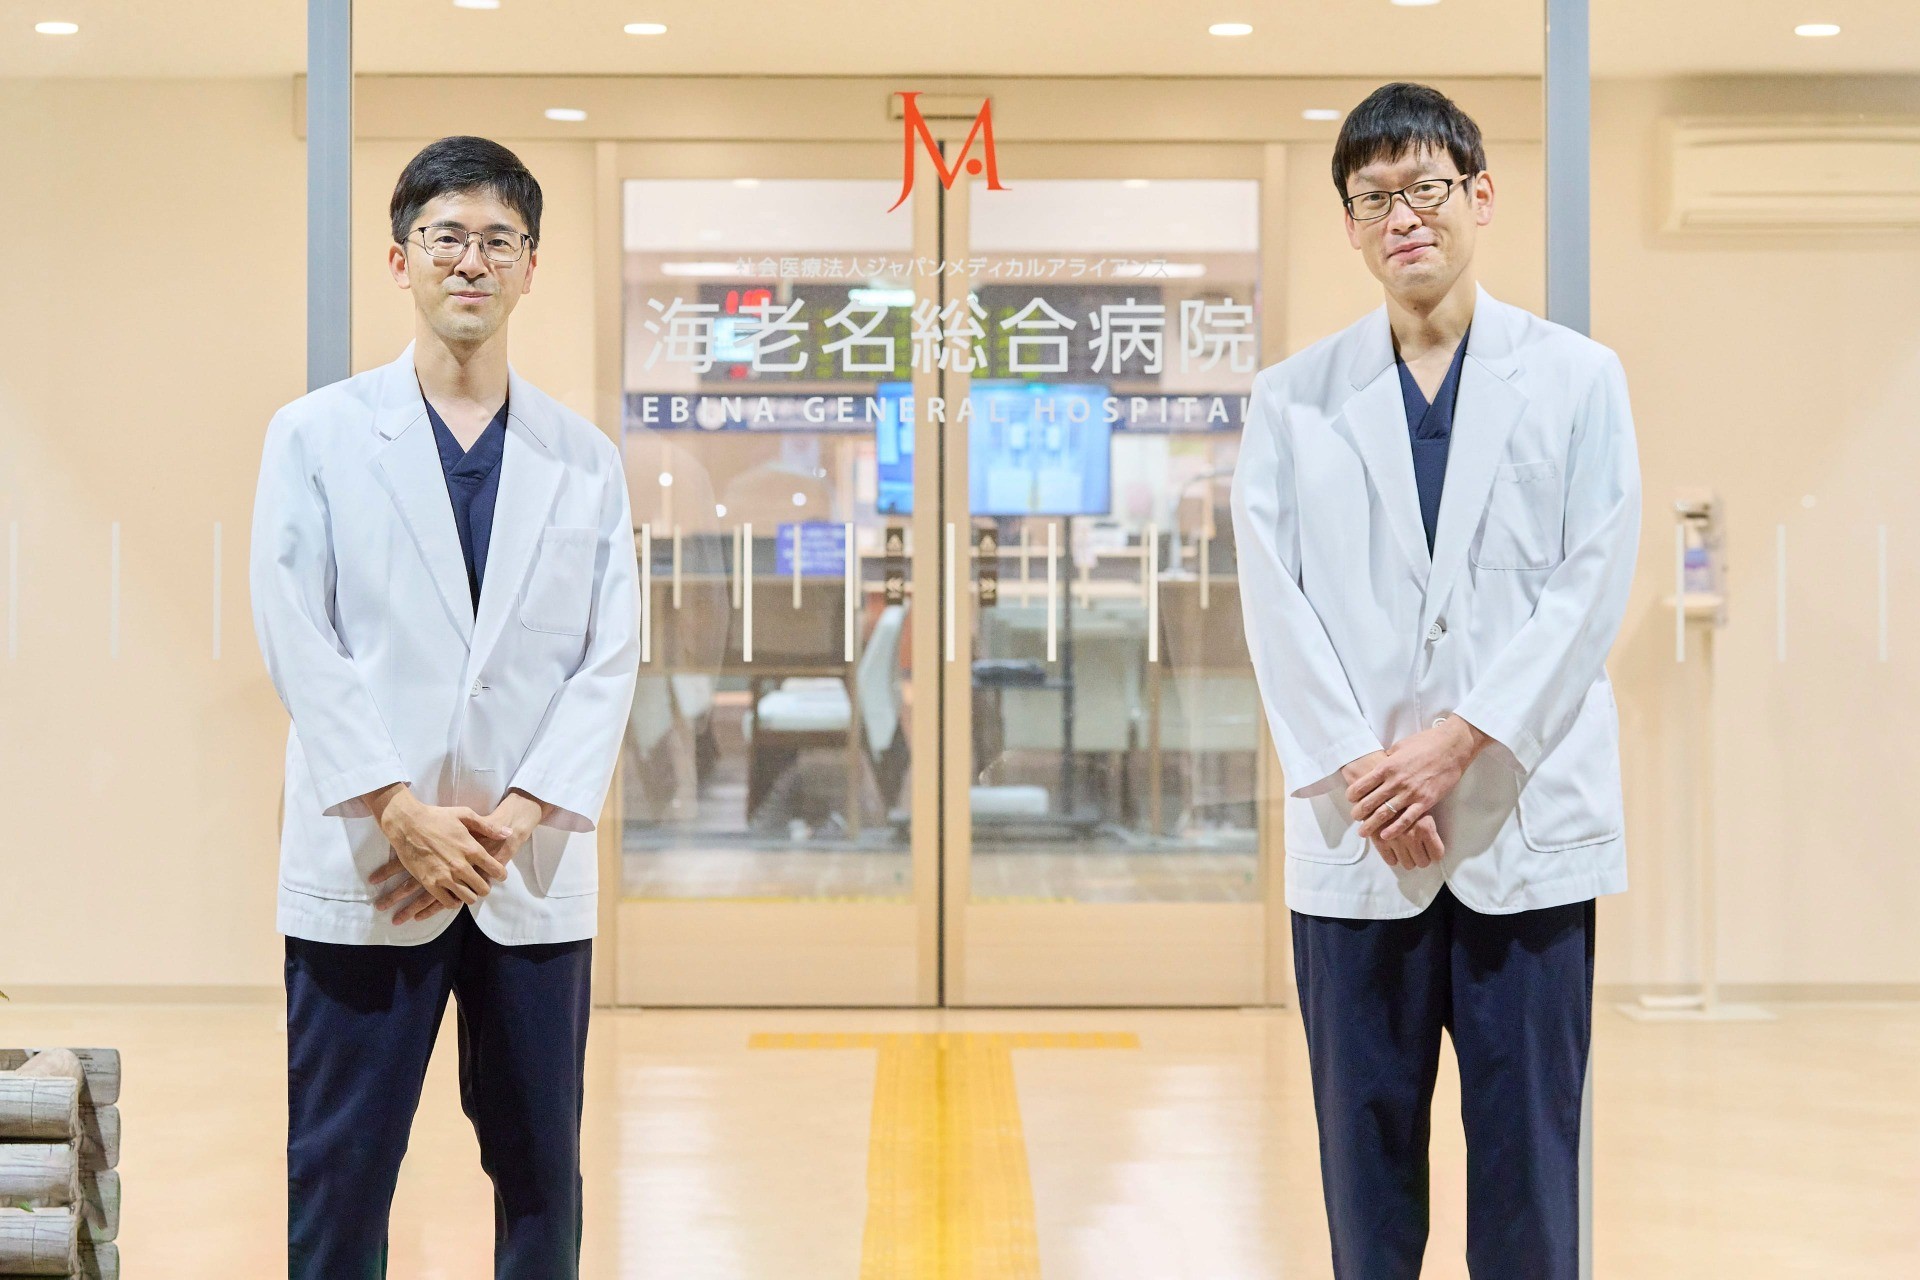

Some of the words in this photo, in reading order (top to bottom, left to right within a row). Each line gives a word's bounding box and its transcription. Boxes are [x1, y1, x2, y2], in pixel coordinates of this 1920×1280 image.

[643, 297, 1255, 375] 海老名総合病院
[642, 396, 775, 424] EBINA
[803, 396, 1006, 424] GENERAL
